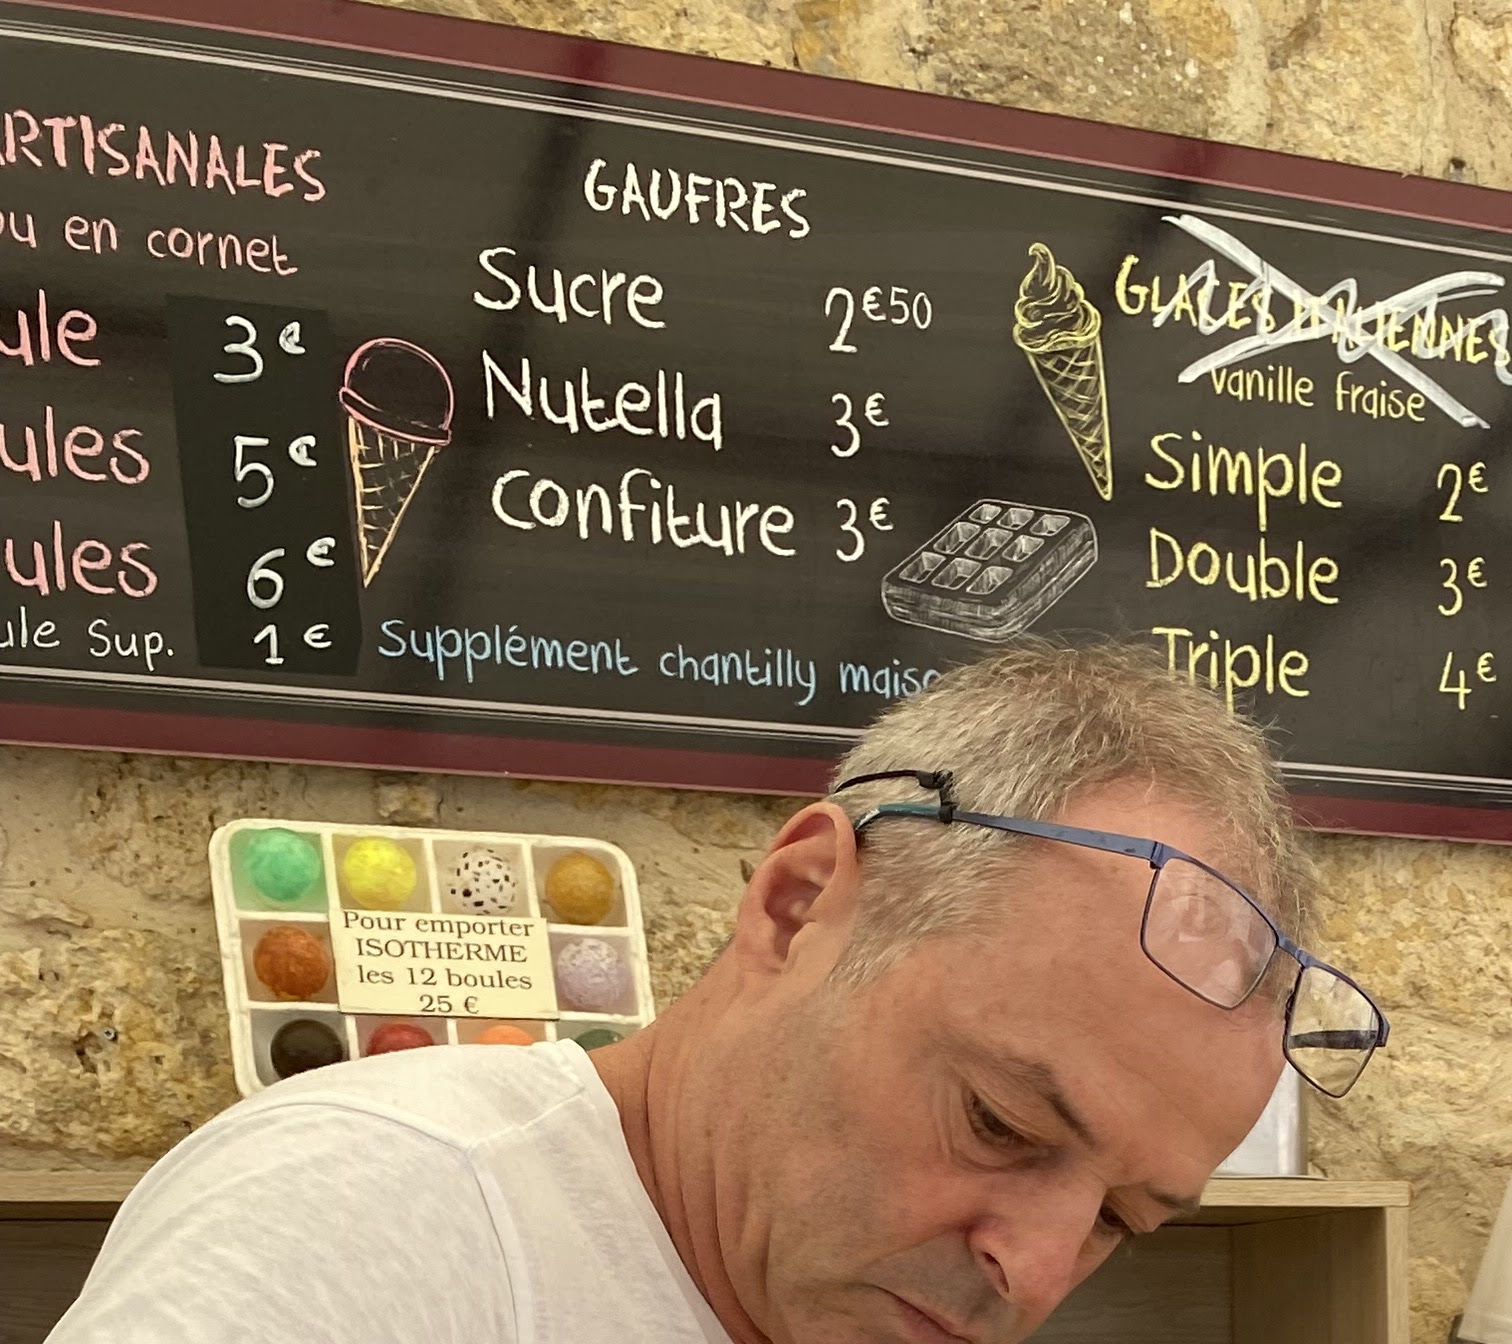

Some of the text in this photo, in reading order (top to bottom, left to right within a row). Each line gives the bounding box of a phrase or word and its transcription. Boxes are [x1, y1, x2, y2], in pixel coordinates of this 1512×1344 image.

[0, 109, 327, 203] RTISANALES
[583, 157, 811, 240] GAUFRES
[64, 215, 118, 255] en
[147, 225, 298, 277] cornet
[472, 246, 932, 354] Sucre 2€50
[481, 349, 889, 458] Nutella 3€
[1336, 371, 1426, 422] fraise
[491, 467, 894, 562] Confiture 3€
[1145, 431, 1489, 532] Simple 2€
[246, 536, 337, 609] 6€
[1146, 526, 1488, 616] Double 3€
[88, 619, 174, 672] Sup.
[378, 619, 639, 683] Supplément
[659, 643, 818, 706] chantilly
[1152, 627, 1497, 718] Triple 4€
[343, 910, 535, 939] Pour emporter
[355, 937, 528, 963] ISOTHERME
[357, 964, 533, 990] les 12 boules
[419, 994, 480, 1015] 25 €
